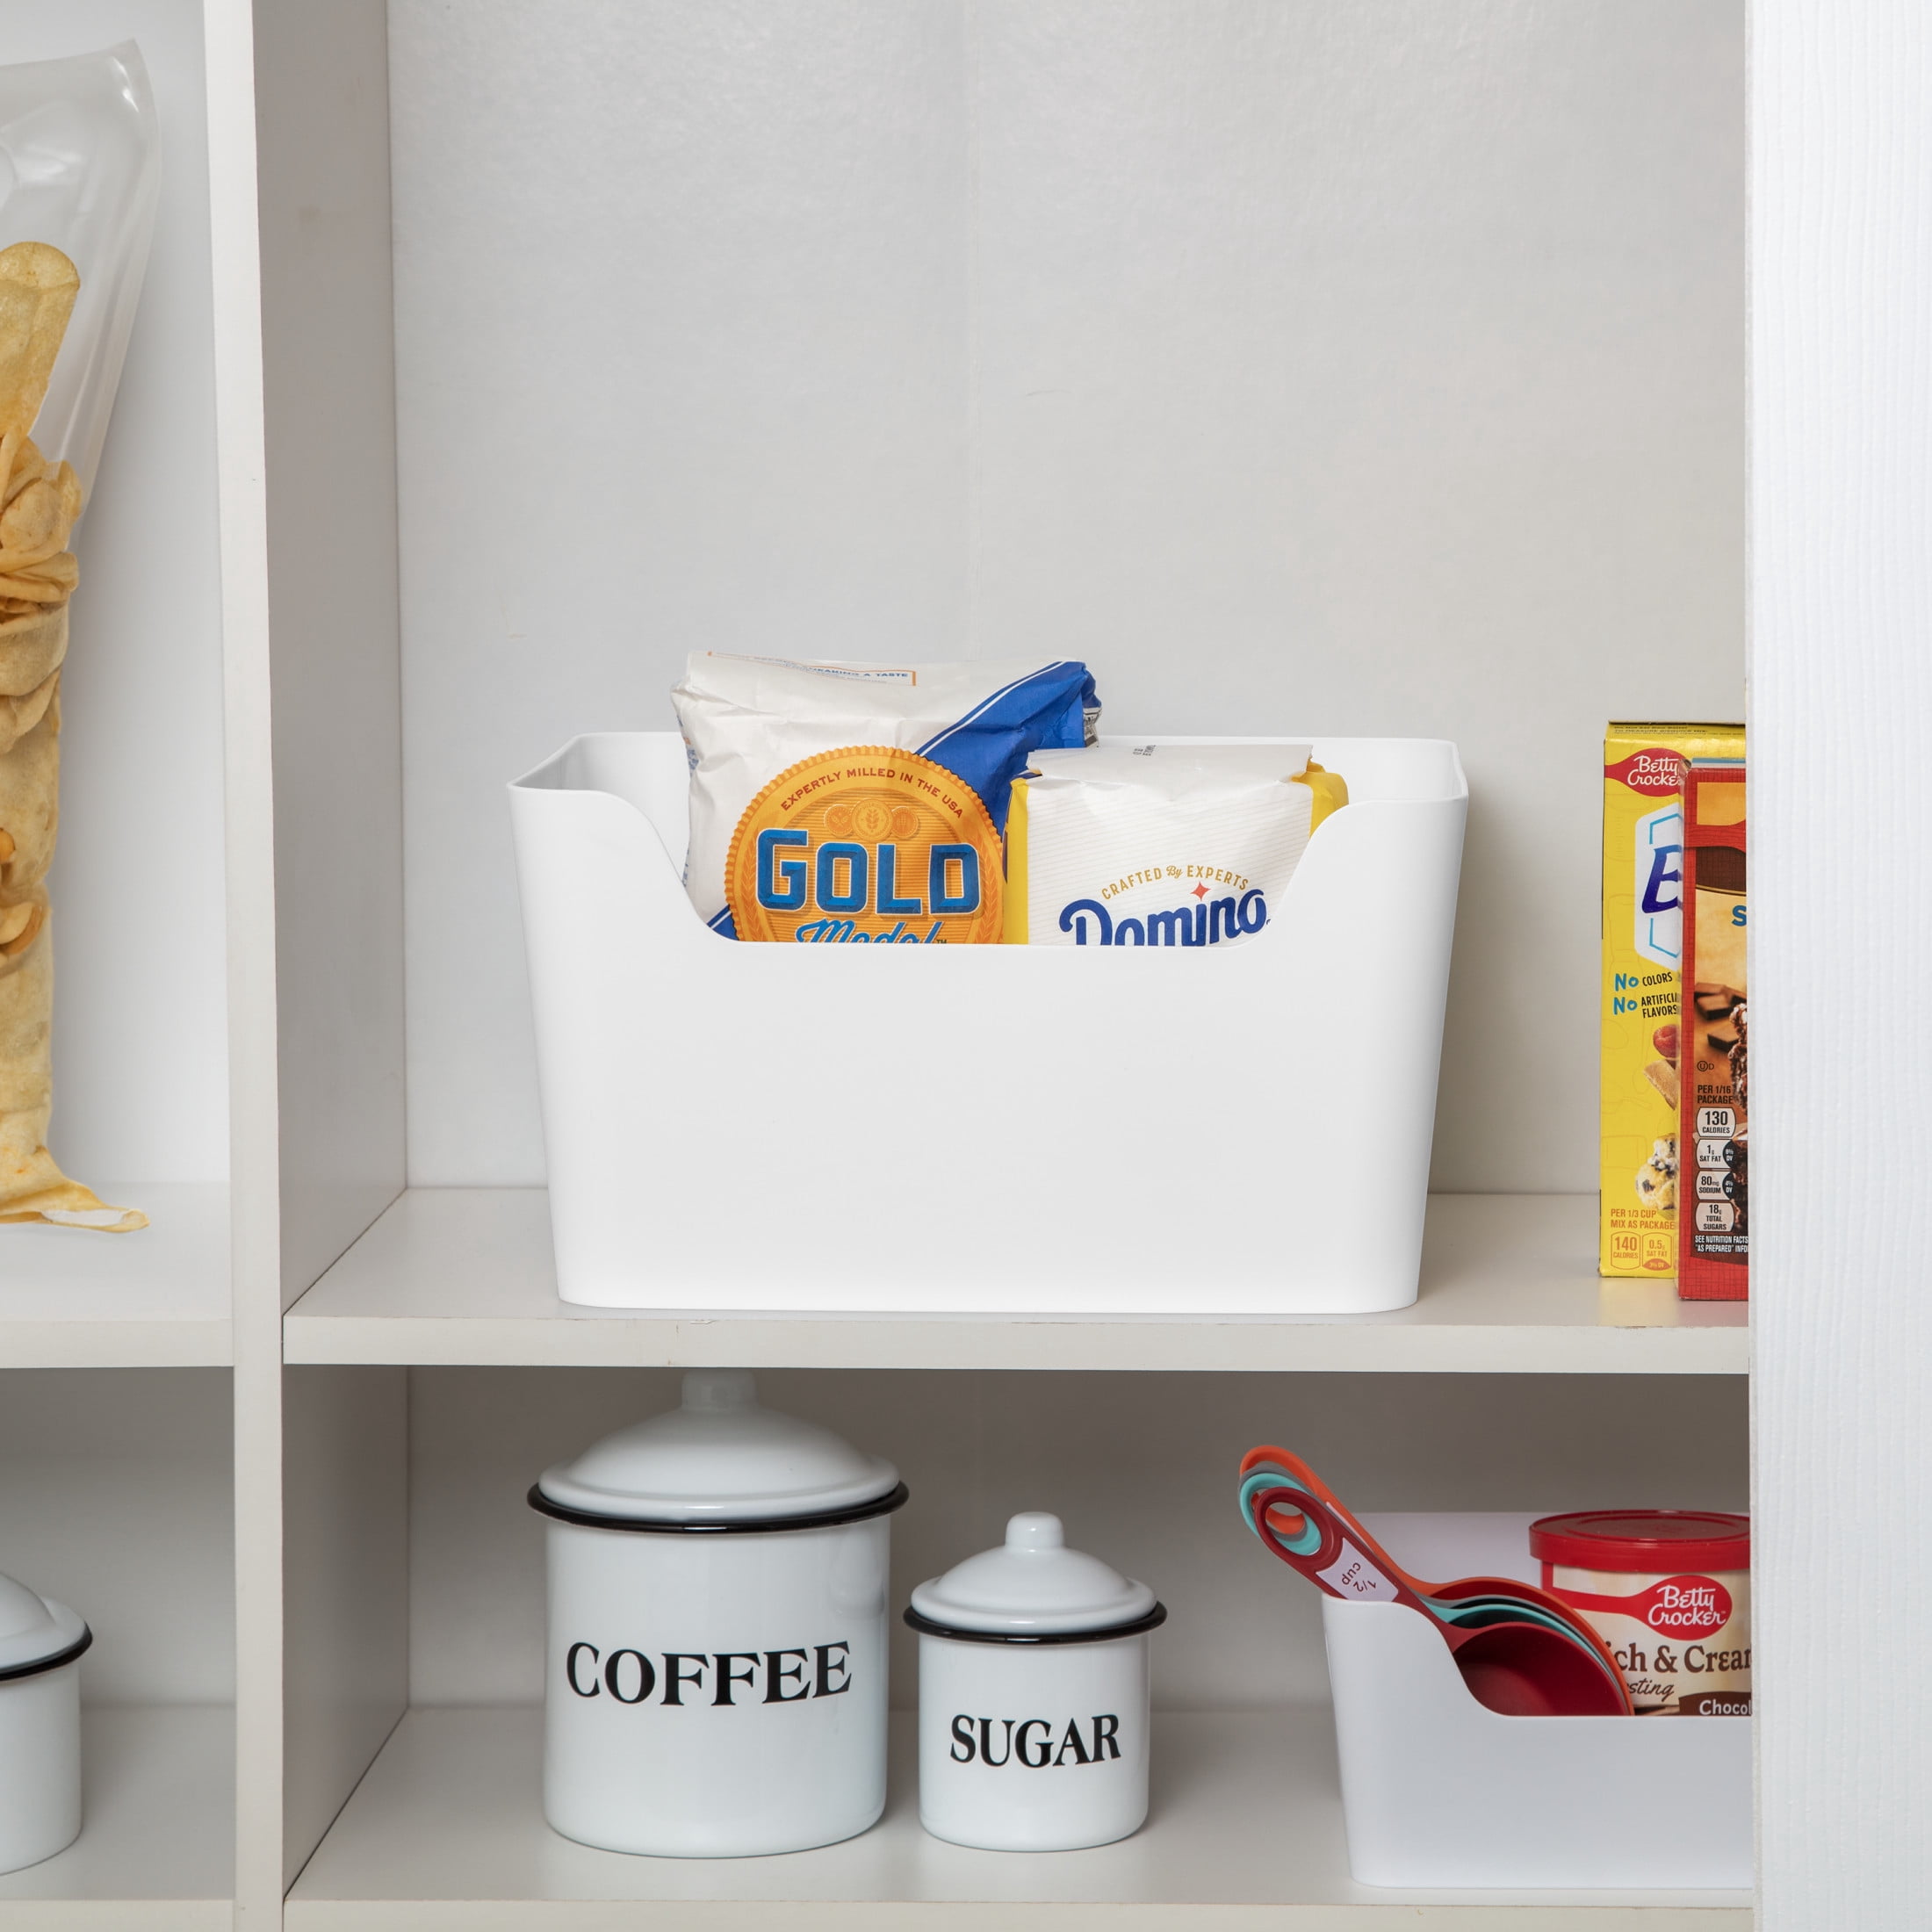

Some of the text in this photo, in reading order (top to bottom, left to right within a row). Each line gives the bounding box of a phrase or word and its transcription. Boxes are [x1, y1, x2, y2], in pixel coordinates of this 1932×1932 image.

[1633, 755, 1679, 775] Betty
[781, 768, 964, 818] EXPERTLY MILLED IN THE USA
[756, 828, 981, 916] GOLD
[1101, 864, 1249, 900] CRAFTED By EXPERTS
[1059, 887, 1267, 947] Domino
[1615, 971, 1673, 991] No COLORS
[1613, 996, 1638, 1015] No
[1642, 1005, 1677, 1019] FLAVORS
[1698, 1085, 1731, 1094] PER 1/16
[1698, 1095, 1734, 1104] PACKAGE
[1705, 1111, 1728, 1126] 130
[1611, 1208, 1656, 1218] PER 1/3 CUP
[1611, 1219, 1626, 1229] MIX
[1628, 1220, 1638, 1229] AS
[1615, 1236, 1638, 1251] 140
[1695, 1235, 1705, 1244] SEE
[1341, 1562, 1361, 1586] cup
[1352, 1580, 1377, 1592] 1/2
[1656, 1584, 1716, 1611] Betty
[1647, 1603, 1726, 1626] Crocker
[1654, 1645, 1678, 1673] &
[566, 1640, 853, 1706] COFFEE
[949, 1713, 1121, 1769] SUGAR
